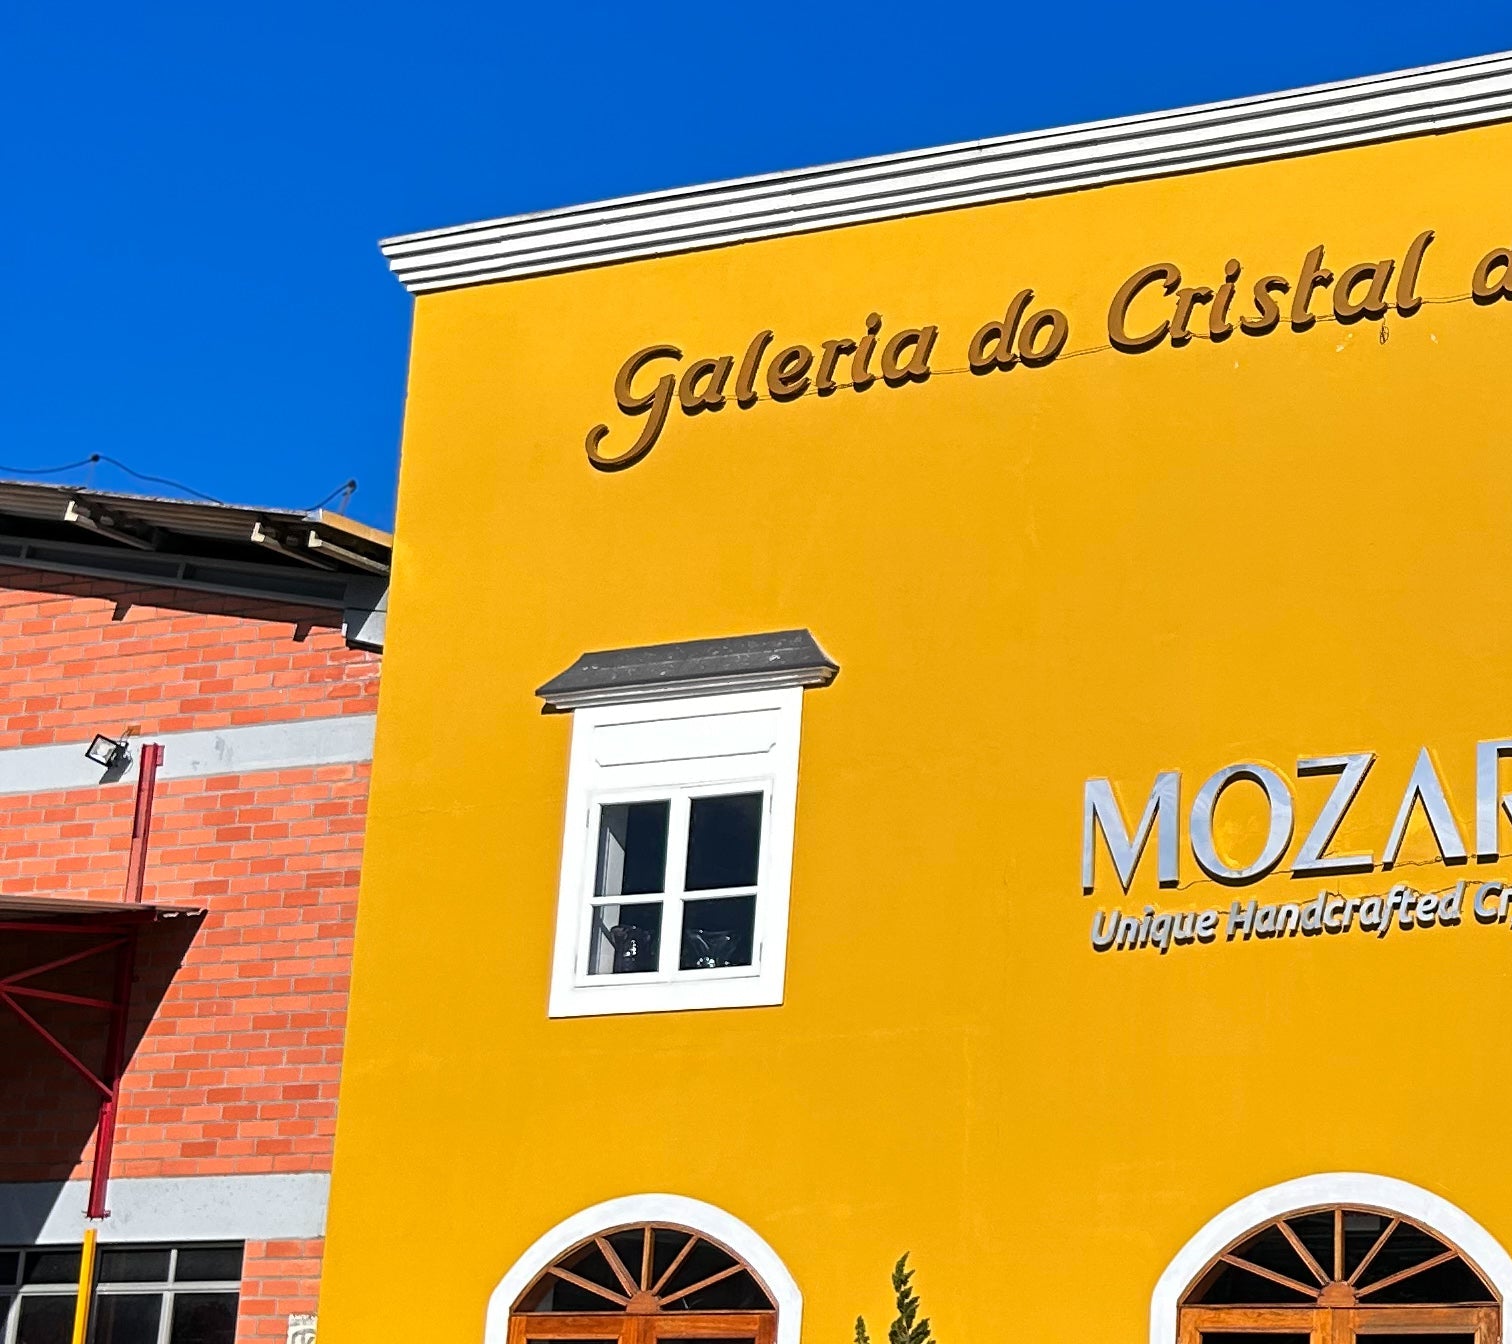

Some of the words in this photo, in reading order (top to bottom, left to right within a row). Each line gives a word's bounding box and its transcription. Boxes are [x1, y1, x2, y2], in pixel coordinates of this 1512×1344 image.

[585, 313, 938, 472] Galeria
[968, 289, 1069, 368] do
[1107, 230, 1435, 353] Cristal
[1091, 905, 1219, 954] Unique
[1225, 880, 1464, 938] Handcrafted
